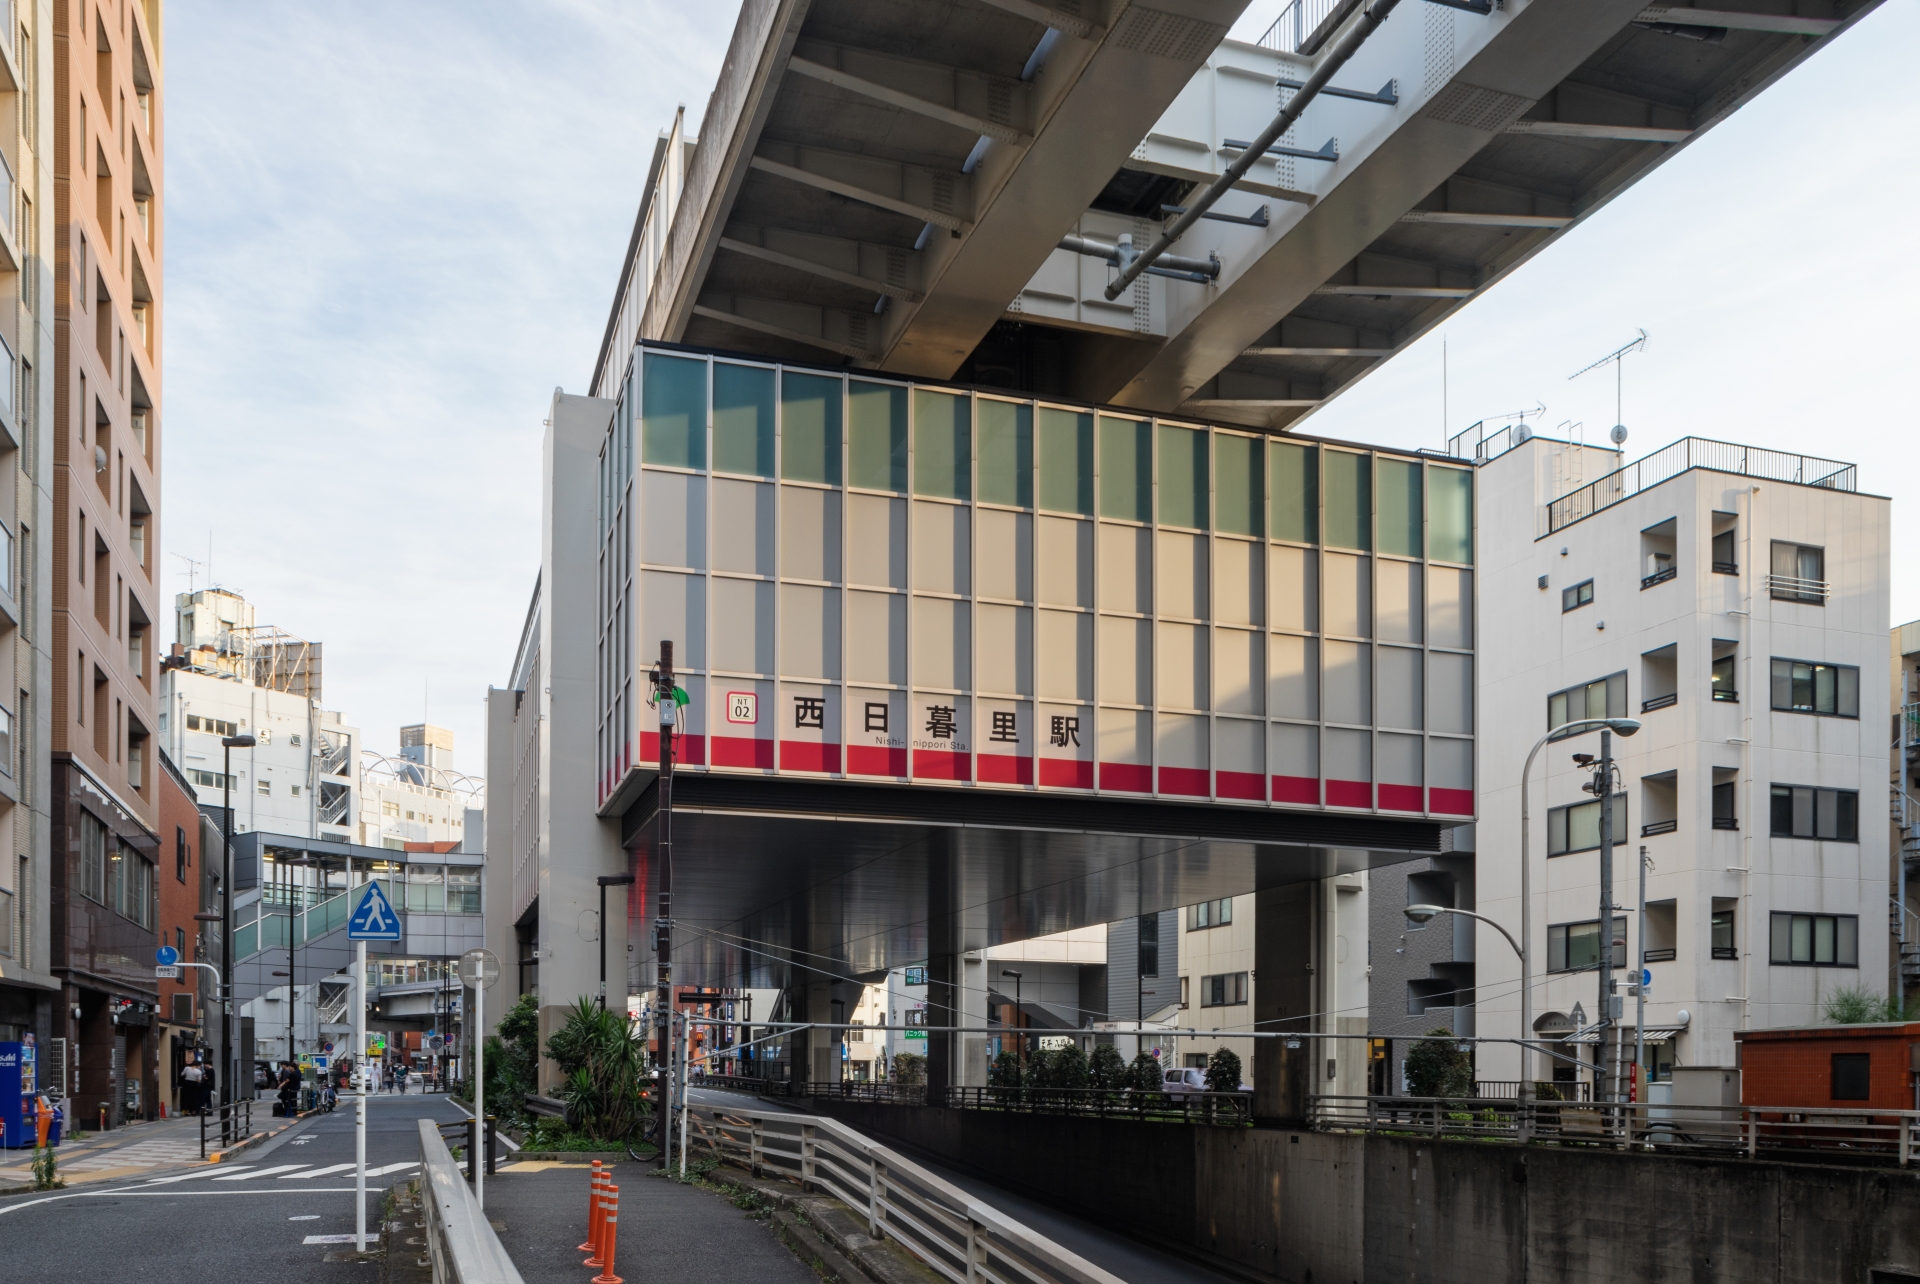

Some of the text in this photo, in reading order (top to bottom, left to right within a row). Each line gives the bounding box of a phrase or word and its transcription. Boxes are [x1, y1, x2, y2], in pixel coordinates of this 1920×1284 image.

[734, 705, 750, 718] 02
[794, 696, 1081, 748] 西日暮里駅
[950, 741, 969, 751] Sta.
